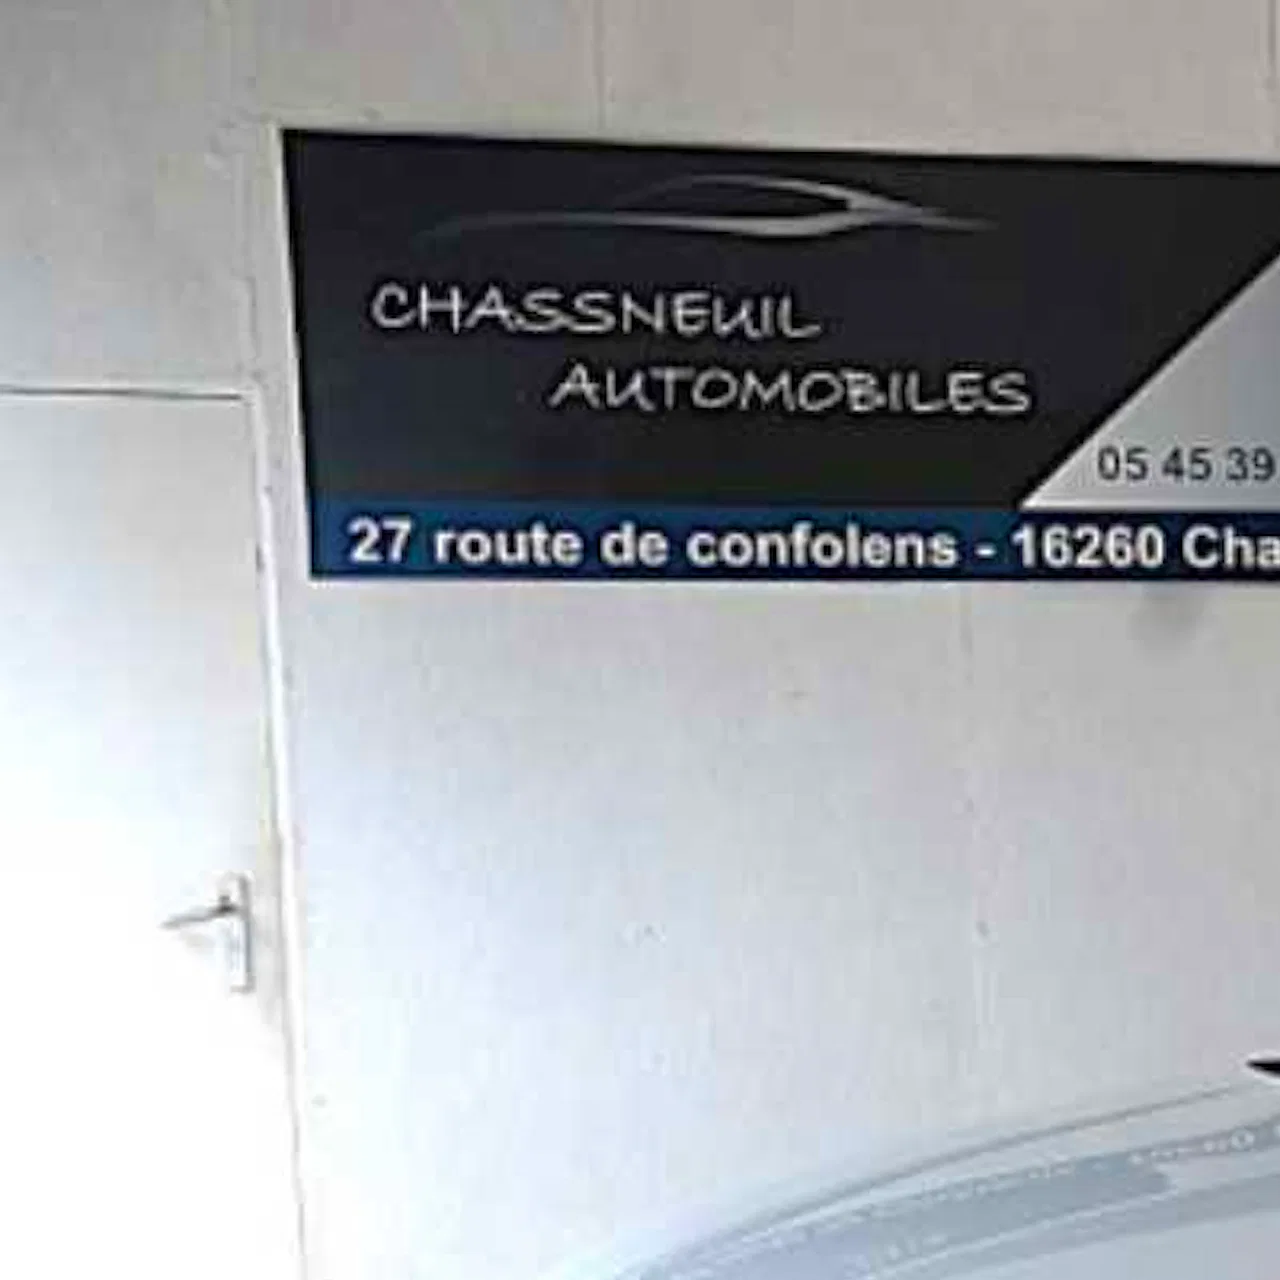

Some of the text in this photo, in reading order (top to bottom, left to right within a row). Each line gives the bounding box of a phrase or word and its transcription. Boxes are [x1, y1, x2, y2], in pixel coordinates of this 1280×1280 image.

[370, 282, 822, 338] CHASSNEUIL
[549, 362, 1031, 414] AUTOMOBILES
[1097, 447, 1148, 482] 05
[1162, 447, 1212, 483] 45
[1226, 447, 1275, 483] 39
[347, 519, 411, 563] 27
[436, 523, 582, 566] route
[601, 521, 668, 566] de
[686, 521, 957, 568] confolens
[1013, 526, 1164, 568] 16260
